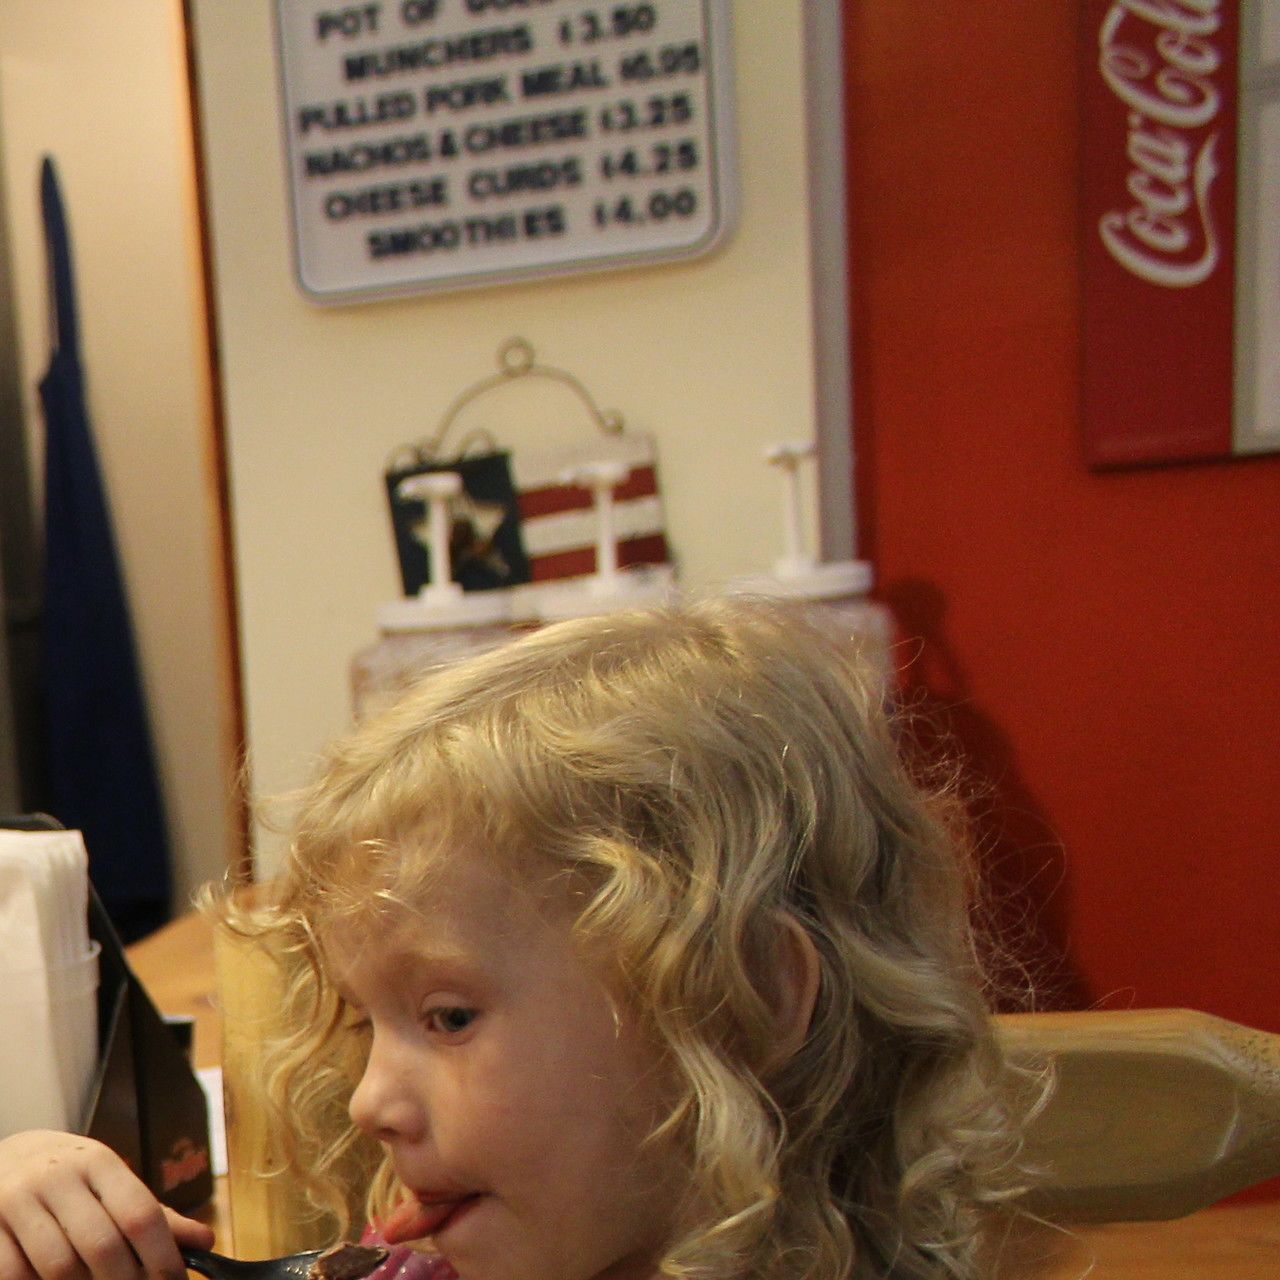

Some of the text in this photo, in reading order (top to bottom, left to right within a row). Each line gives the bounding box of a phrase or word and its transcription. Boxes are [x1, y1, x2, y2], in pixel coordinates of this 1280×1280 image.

[344, 22, 532, 80] MUNCHERS
[298, 90, 417, 135] PULLED
[426, 74, 509, 114] PORK
[521, 62, 609, 97] MEAL
[305, 131, 430, 175] NACHOS
[464, 106, 588, 153] CHEESE
[324, 174, 446, 221] CHEESE
[468, 157, 582, 200] CURDS
